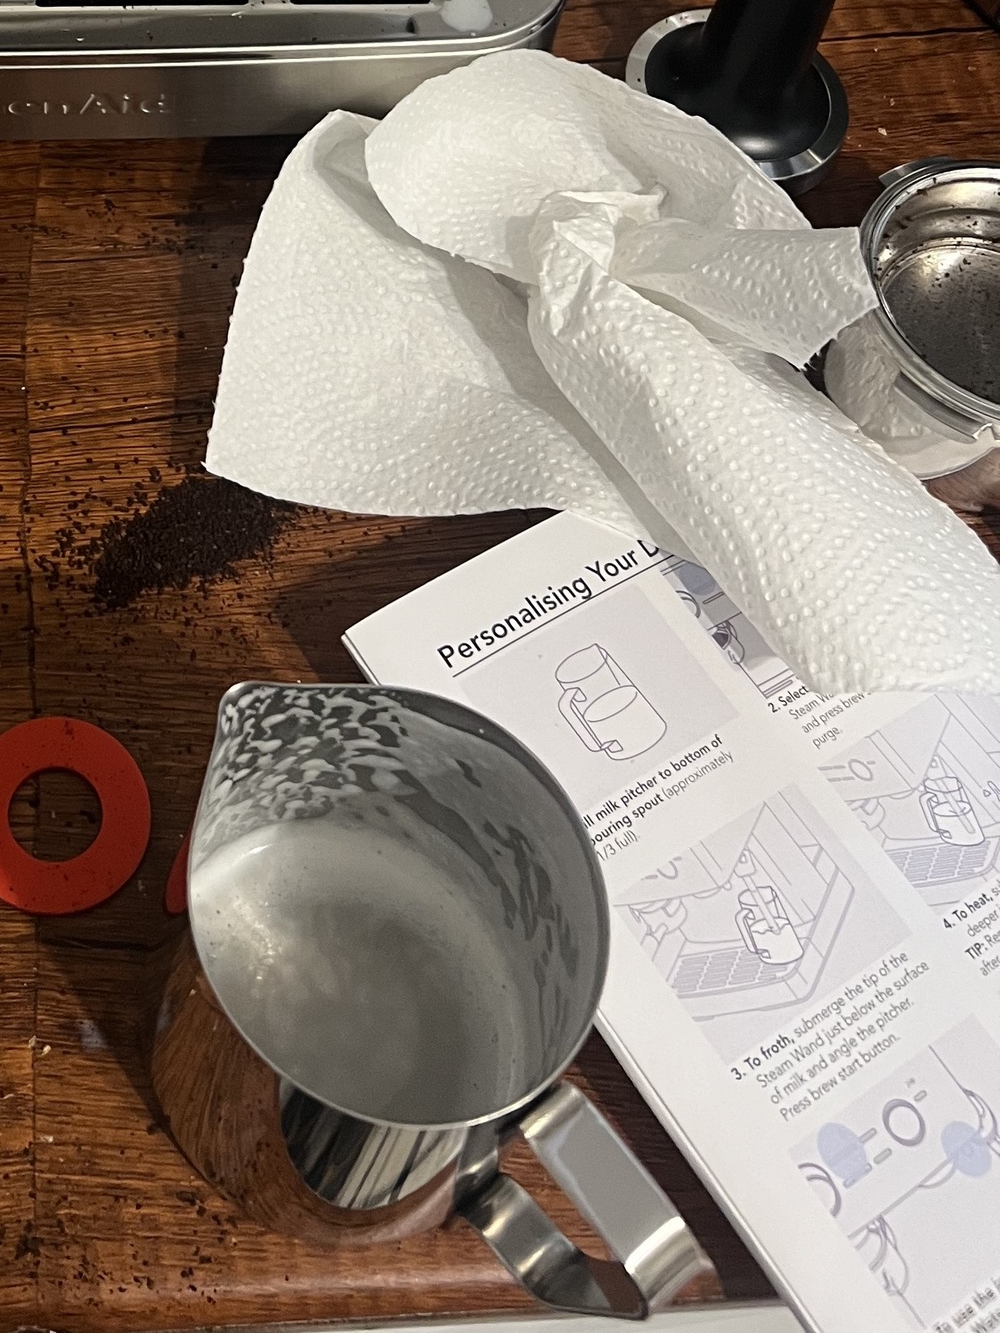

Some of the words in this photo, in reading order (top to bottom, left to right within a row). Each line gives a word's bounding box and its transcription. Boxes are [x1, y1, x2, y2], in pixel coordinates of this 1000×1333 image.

[437, 577, 592, 668] Personalising
[585, 549, 639, 582] Your
[768, 702, 780, 713] 2.
[778, 686, 809, 707] Select
[788, 699, 820, 720] Steam
[802, 716, 821, 734] and
[820, 706, 844, 725] press
[840, 692, 865, 709] brew
[812, 726, 843, 750] purge.
[595, 800, 620, 821] milk
[620, 776, 658, 808] pitcher
[658, 768, 672, 780] to
[670, 744, 711, 772] bottom
[711, 733, 723, 748] of
[632, 793, 665, 819] spout
[661, 750, 735, 799] (approximately
[596, 844, 616, 861] 1/3
[943, 918, 955, 929] 4.
[952, 910, 968, 921] To
[964, 893, 994, 914] heat,
[967, 910, 999, 938] deeper
[965, 942, 988, 960] TIP:
[730, 1067, 746, 1081] 3.
[743, 1056, 761, 1071] To
[760, 1034, 796, 1062] froth,
[794, 997, 846, 1038] submerge
[844, 983, 864, 1002] the
[862, 972, 879, 992] tip
[879, 960, 891, 977] of
[888, 951, 909, 970] the
[756, 1059, 793, 1089] Steam
[789, 1033, 825, 1062] Wand
[823, 1021, 846, 1046] just
[843, 999, 877, 1026] below
[874, 986, 894, 1004] the
[892, 961, 930, 991] surface
[770, 1087, 782, 1105] of
[782, 1072, 809, 1096] milk
[807, 1054, 829, 1079] and
[828, 1037, 859, 1064] angle
[856, 1023, 876, 1042] the
[874, 997, 915, 1032] pitcher.
[779, 1098, 811, 1123] Press
[809, 1077, 839, 1101] brew
[837, 1059, 863, 1082] start
[857, 1033, 901, 1063] button.
